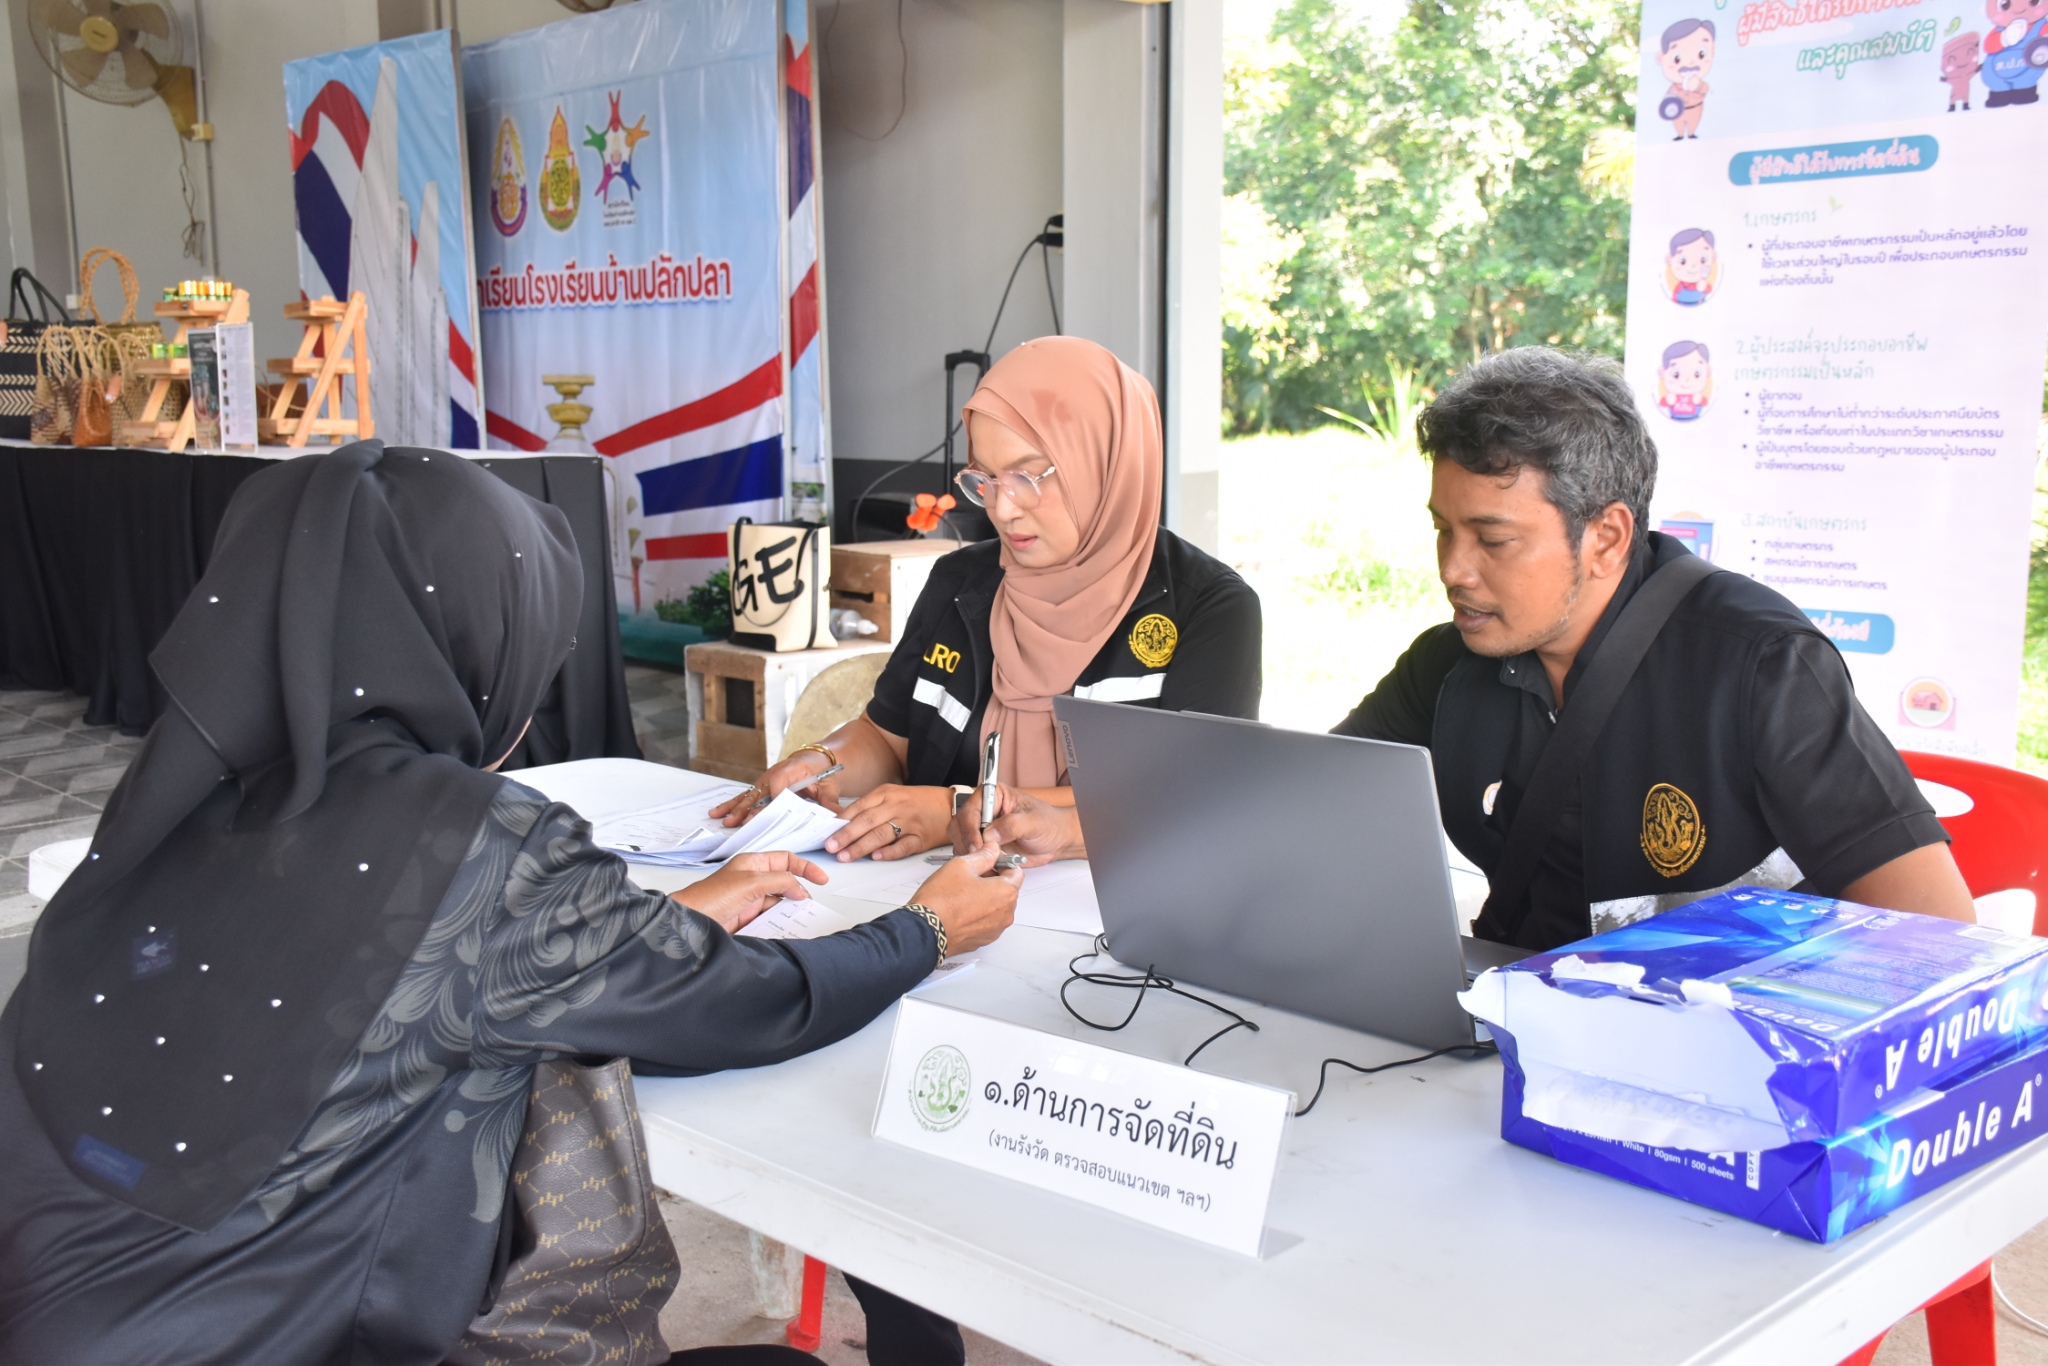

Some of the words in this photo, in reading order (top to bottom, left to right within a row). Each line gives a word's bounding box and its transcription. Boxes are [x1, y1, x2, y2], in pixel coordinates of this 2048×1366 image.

[1797, 19, 1937, 79] และคุณสมบัติ
[1743, 209, 1818, 228] 1.เกษตรกร
[1733, 353, 1875, 380] เกษตรกรรมเป็นหลัก
[1062, 724, 1076, 764] Lenovo
[1917, 987, 2020, 1068] Double
[984, 1066, 1238, 1170] ๑.ด้านการจัดที่ดิน
[1886, 1101, 2001, 1189] Double
[2011, 1080, 2032, 1129] A
[989, 1129, 1049, 1162] (งานรังวัด
[1054, 1150, 1171, 1199] ตรวจสอบแนวเขต
[1176, 1187, 1212, 1212] ฯลฯ)
[1622, 1140, 1645, 1153] White
[1653, 1149, 1681, 1164] 80gsm
[1691, 1161, 1706, 1172] 500
[1707, 1165, 1735, 1181] sheets
